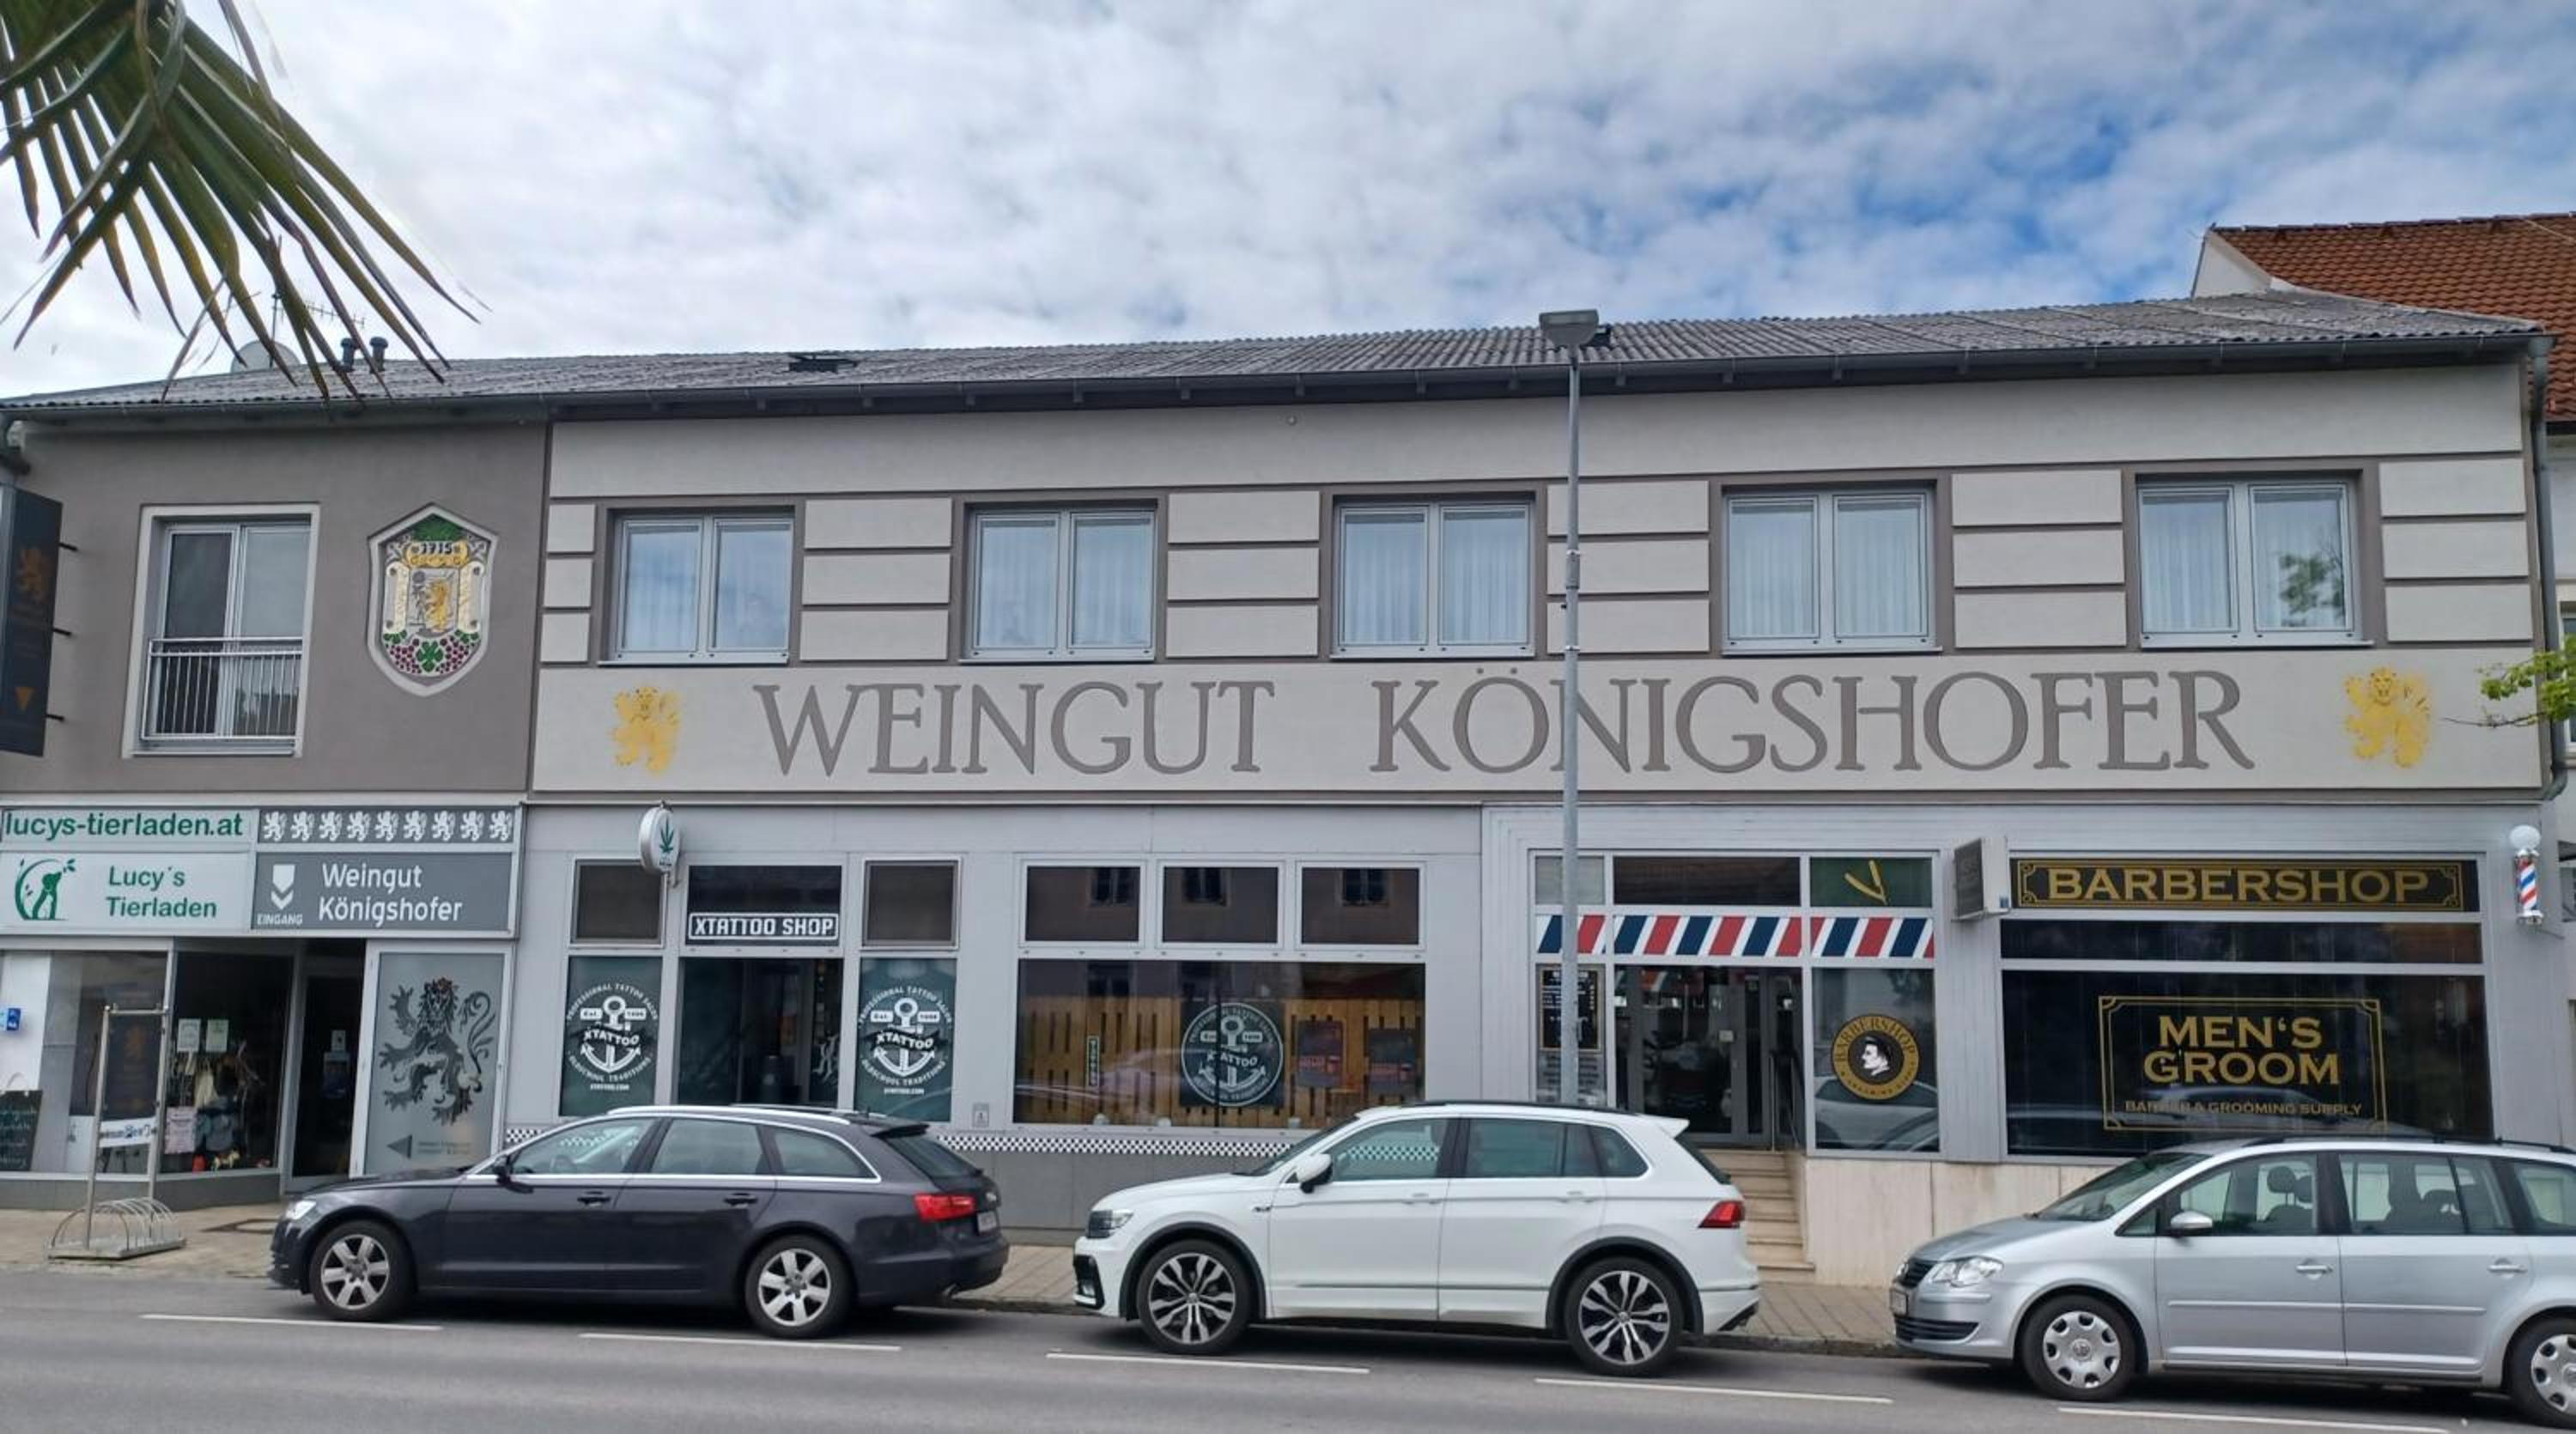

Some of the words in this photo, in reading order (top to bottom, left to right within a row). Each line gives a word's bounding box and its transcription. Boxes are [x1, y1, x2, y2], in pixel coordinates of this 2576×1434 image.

[753, 681, 1275, 776] WEINGUT
[1369, 666, 2255, 775] KÖNIGSHOFER
[5, 812, 244, 842] lucys-tierladen.at
[322, 862, 422, 894] Weingut
[2048, 867, 2429, 902] BARBERSHOP
[106, 896, 217, 918] Tierladen
[257, 913, 303, 926] EINGANG
[319, 896, 462, 927] Königshofer
[695, 918, 775, 935] XTATTOO
[782, 918, 834, 935] SHOP
[583, 1027, 640, 1046] XTATTOO
[877, 1030, 933, 1049] XTATTOO
[2143, 1050, 2341, 1085] GROOM
[2208, 1101, 2295, 1114] GROOMING
[2300, 1103, 2363, 1115] SUPPLY
